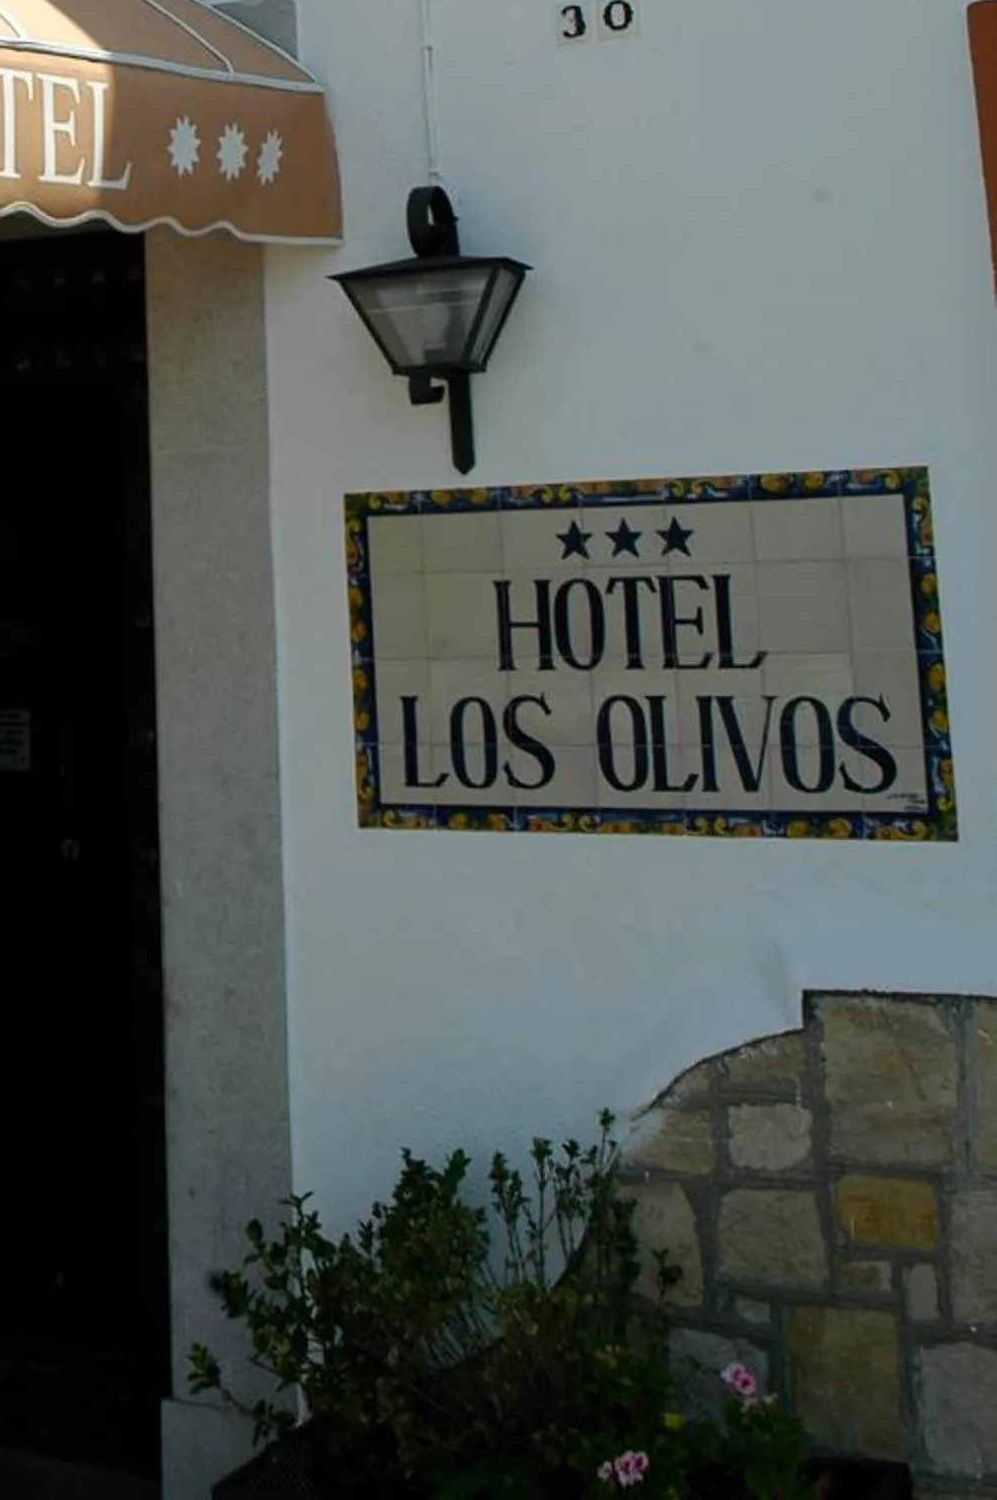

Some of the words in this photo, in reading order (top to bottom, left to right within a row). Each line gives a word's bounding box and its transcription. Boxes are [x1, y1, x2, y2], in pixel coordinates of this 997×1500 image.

[560, 0, 633, 39] 30
[493, 573, 768, 671] HOTEL
[400, 692, 556, 790] LOS
[596, 694, 898, 794] OLIVOS
